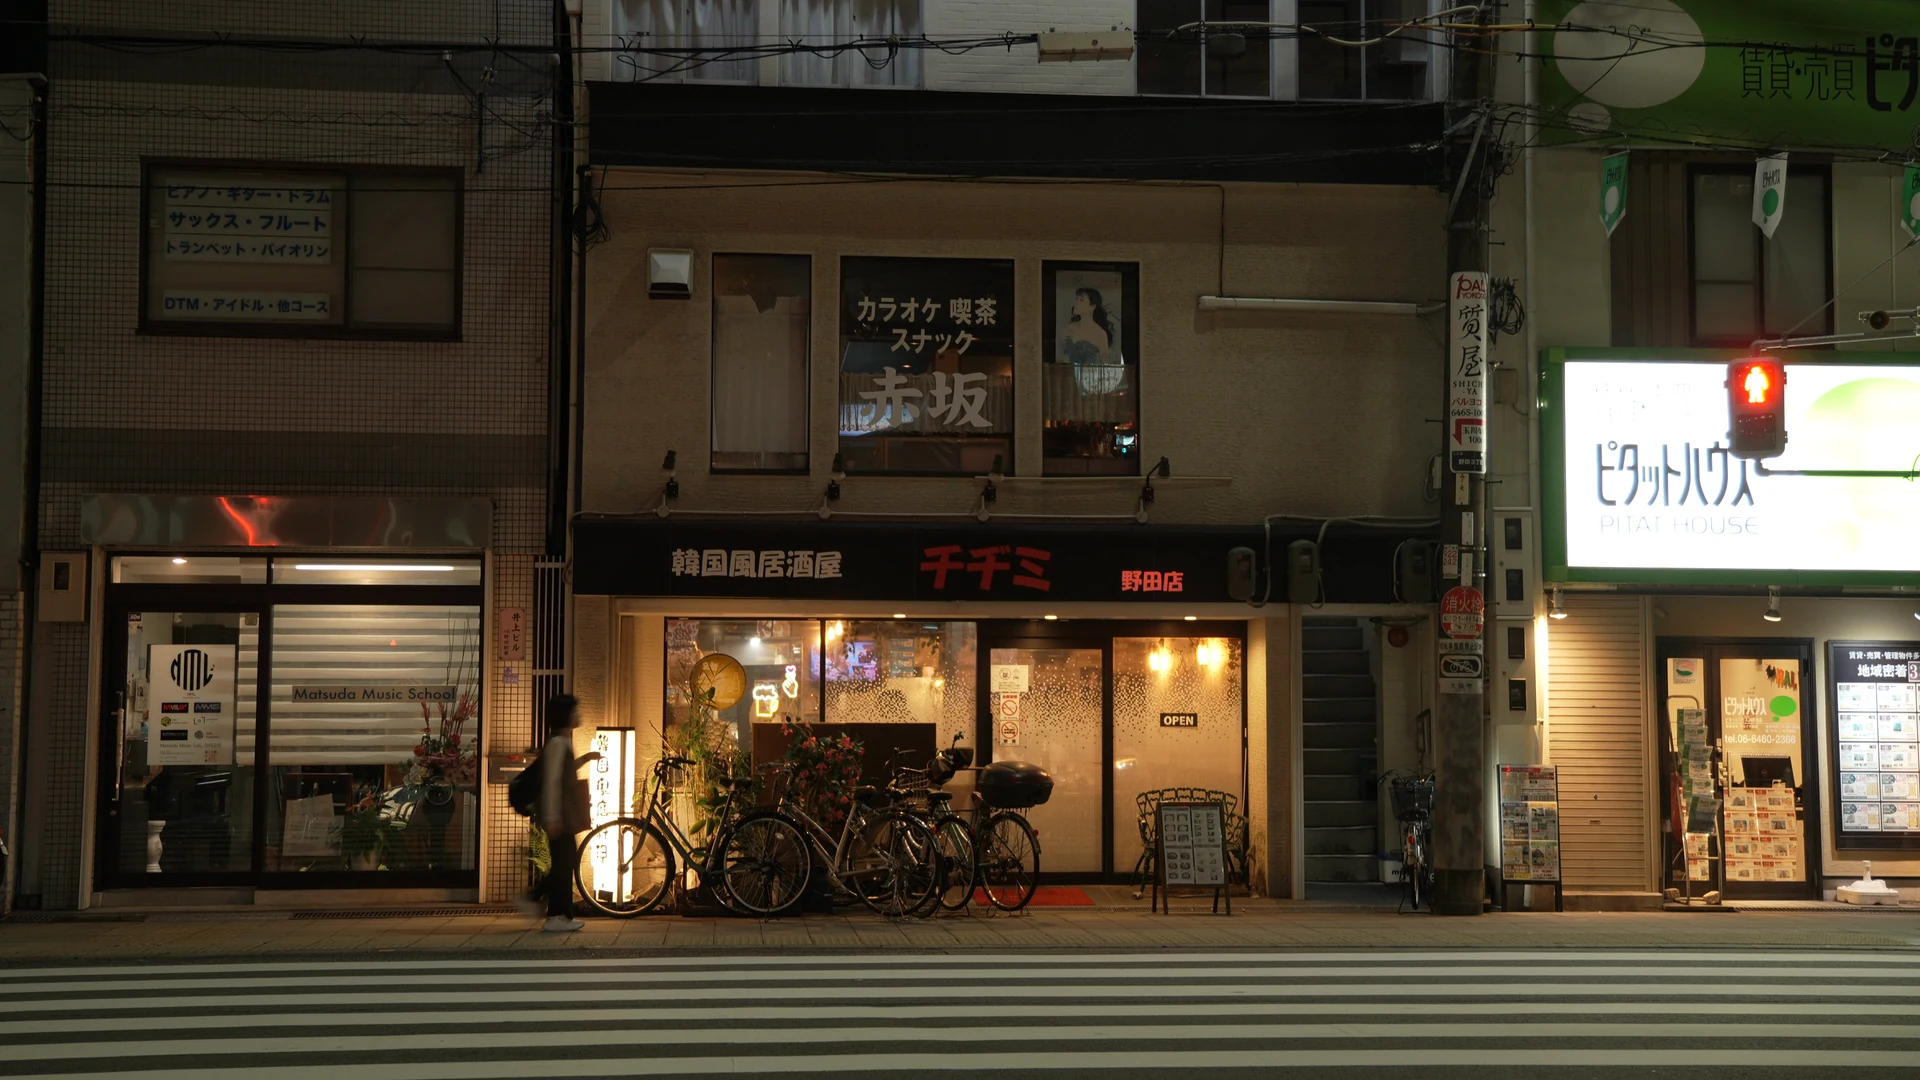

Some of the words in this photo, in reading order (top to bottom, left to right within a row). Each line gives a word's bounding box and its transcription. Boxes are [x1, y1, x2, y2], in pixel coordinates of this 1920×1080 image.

[168, 185, 330, 203] ピアノ・ギター・ドラム
[169, 212, 327, 231] サックス・フルート
[166, 241, 328, 257] トランペット・バイオリン
[164, 298, 328, 313] DTM・アイドル・他コース
[857, 296, 942, 323] カラオケ
[949, 297, 997, 325] 喫茶
[891, 328, 974, 355] スナック
[1458, 303, 1484, 377] 質屋
[859, 366, 994, 428] 赤坂
[1595, 440, 1754, 507] ピタットハウス
[1601, 516, 1667, 534] PITAT
[1674, 516, 1758, 534] HOUSE
[672, 548, 843, 579] 韓国風居酒屋
[920, 544, 1051, 591] チヂミ
[1121, 570, 1184, 592] 野田店
[1446, 596, 1481, 613] 消火栓
[512, 612, 521, 652] 井上ビル
[1857, 664, 1907, 678] 地域密着
[294, 688, 355, 701] Matsuda
[362, 688, 402, 701] Music
[409, 687, 456, 701] School
[1724, 697, 1767, 715] ピタットハウス
[1163, 715, 1194, 726] OPEN
